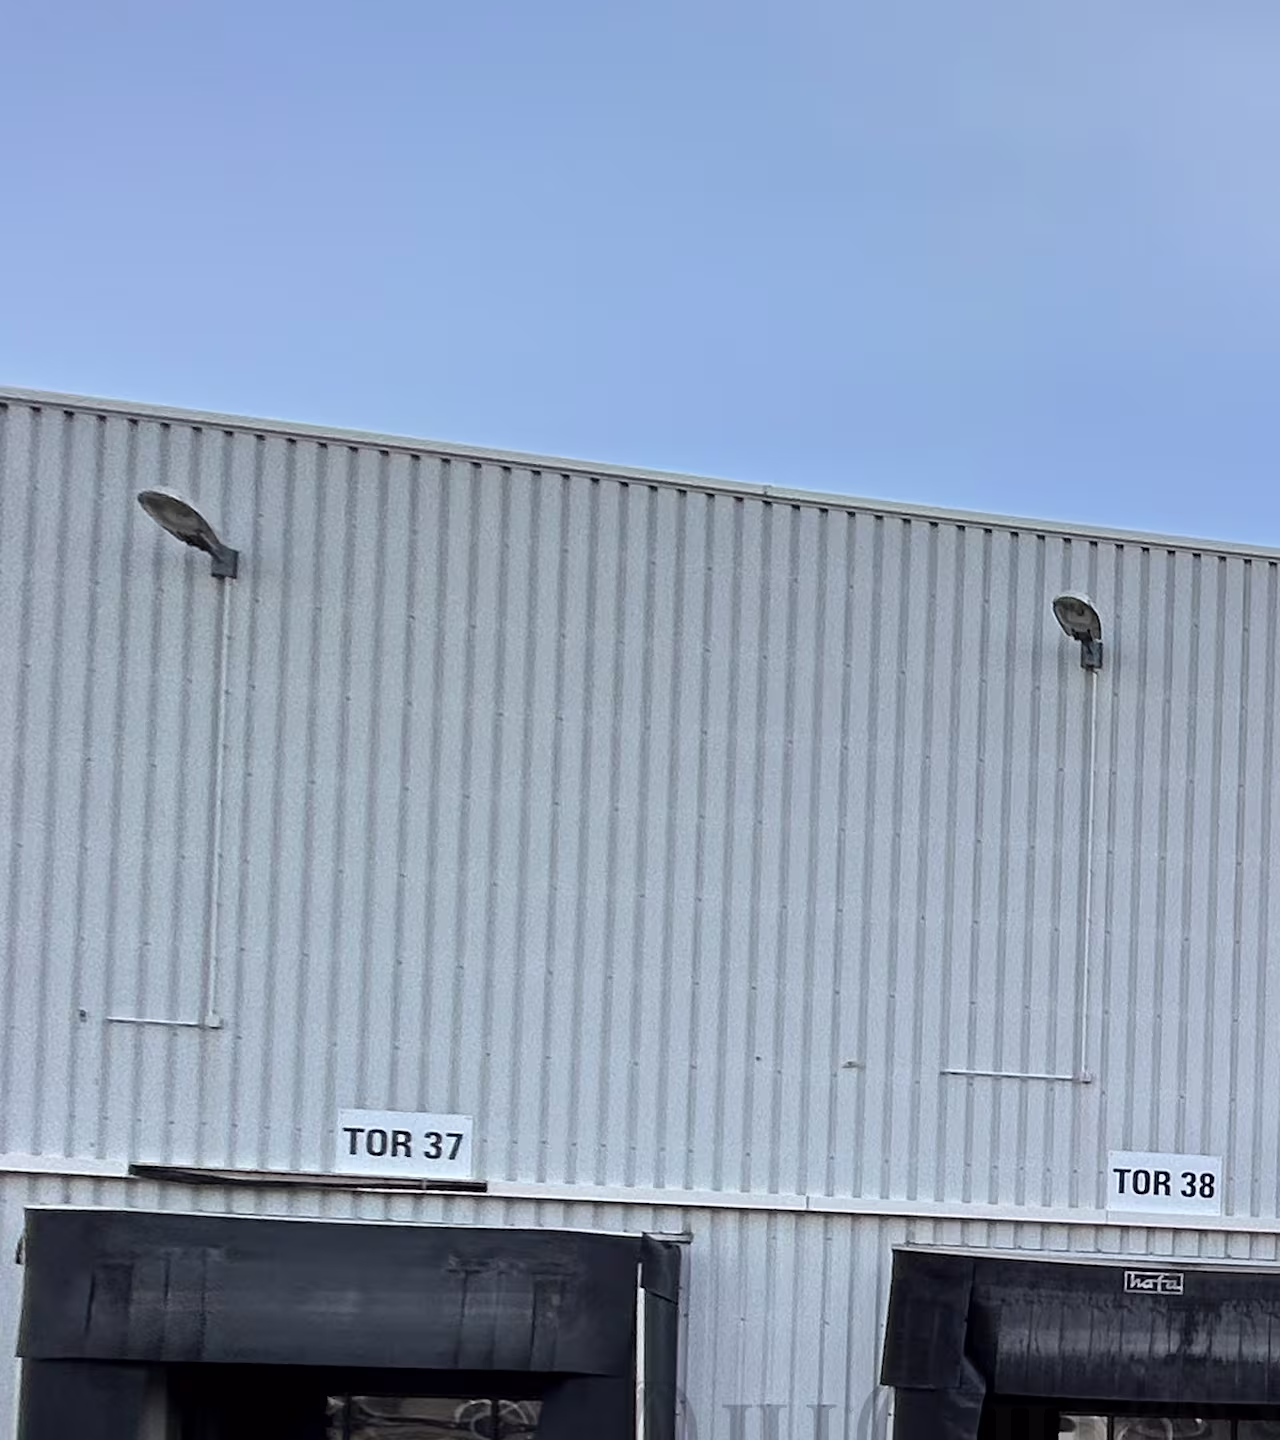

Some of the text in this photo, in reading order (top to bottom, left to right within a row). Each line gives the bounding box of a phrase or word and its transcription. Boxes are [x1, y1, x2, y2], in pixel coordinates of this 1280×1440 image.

[342, 1127, 464, 1160] TOR 37
[1112, 1168, 1215, 1198] TOR 38
[1129, 1273, 1182, 1293] hafa
